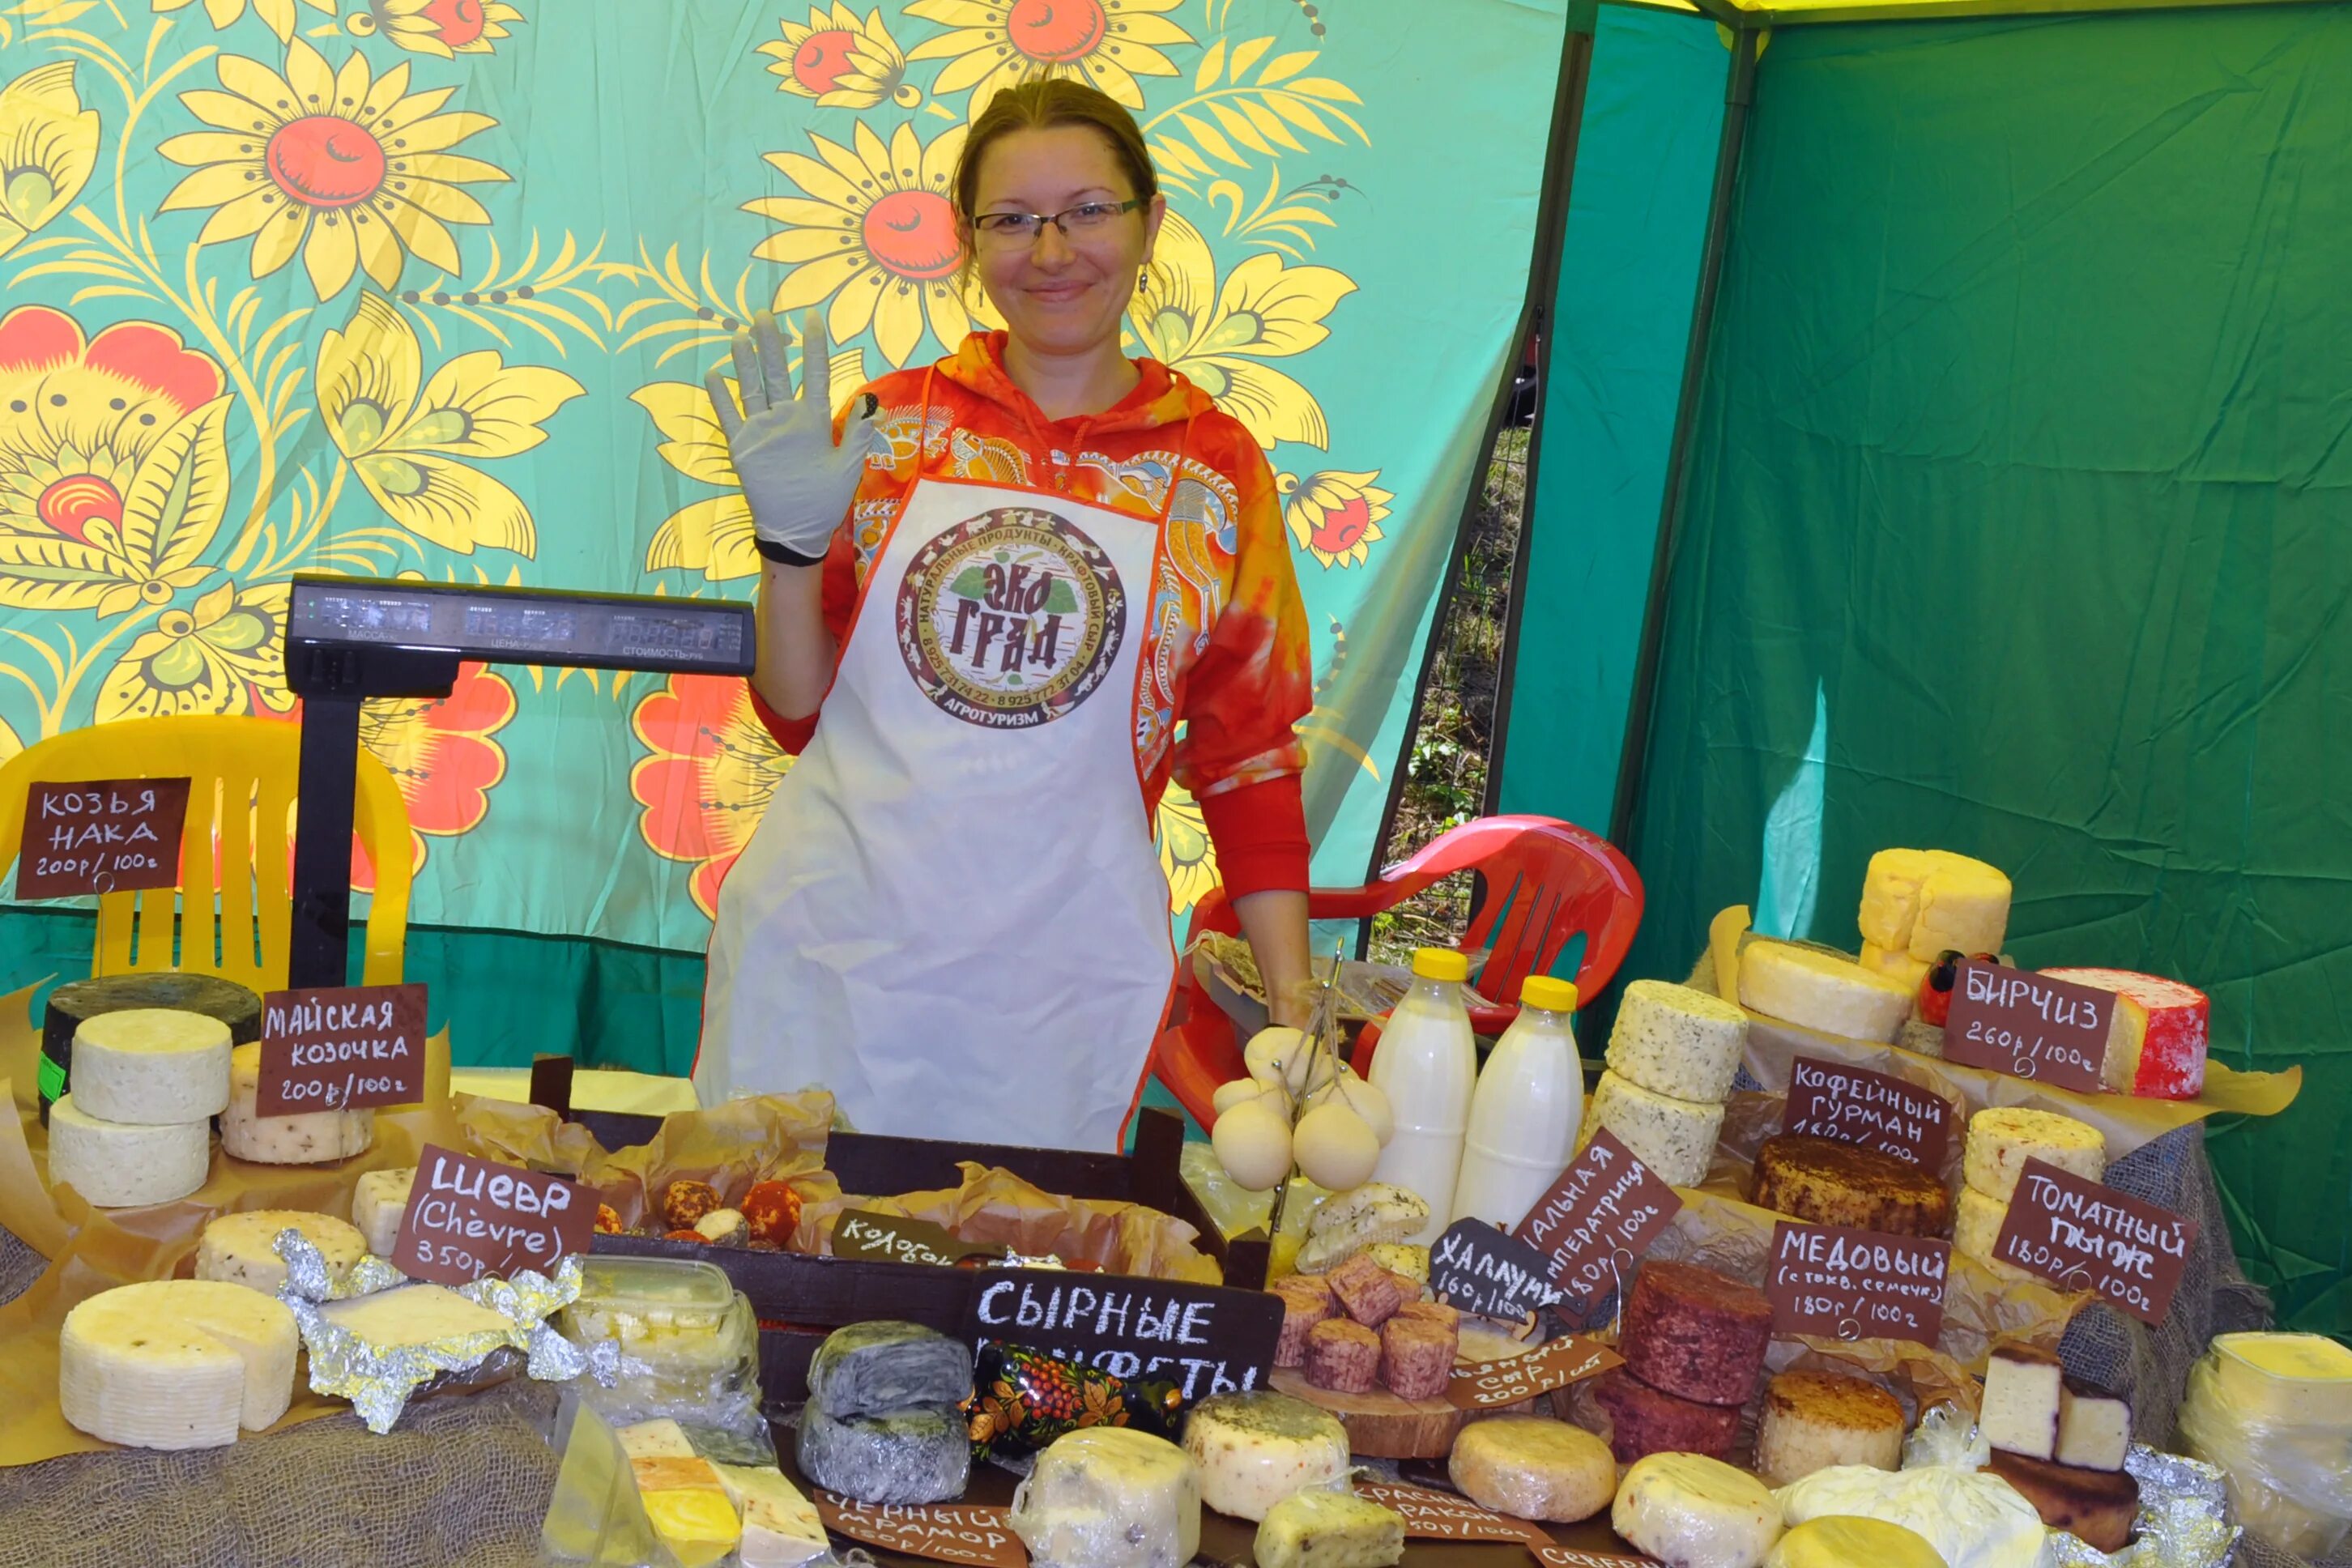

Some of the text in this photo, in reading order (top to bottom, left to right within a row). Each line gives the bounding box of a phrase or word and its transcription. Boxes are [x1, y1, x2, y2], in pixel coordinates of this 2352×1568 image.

[919, 527, 1104, 652] НАТУРАЛЬНЫЕ ПРОДУКТЫ КРАФТОВЫЙ СЫР
[982, 563, 1054, 615] ЭКО
[949, 598, 1062, 673] ГРАД
[927, 647, 941, 669] 925
[940, 668, 957, 687] 731
[958, 682, 973, 697] 74
[974, 690, 989, 703] 22
[998, 696, 1005, 705] 8
[1008, 694, 1032, 706] 925
[1033, 685, 1057, 701] 772
[1058, 675, 1070, 689] 37
[1070, 662, 1084, 676] 04
[944, 698, 1038, 726] АГРОТУРИЗМ
[42, 790, 156, 820] КОЗЬЯ
[49, 821, 159, 851] НАКА
[265, 996, 393, 1039] МАЙСКАЯ
[1966, 966, 2098, 1029] БИРЧИЗ
[291, 1035, 408, 1067] КОЗОЧКА
[1796, 1063, 1941, 1124] КОФЕЙНЫЙ
[1812, 1096, 1922, 1143] ГУРМАН
[1547, 1160, 1645, 1280] МПЕРАТРИЦА
[2028, 1175, 2186, 1259] ТОМАТНЫЙ
[1780, 1229, 1945, 1280] МЕДОВЫЙ
[977, 1280, 1215, 1345] СЫРНЫЕ
[1353, 1487, 1481, 1510] КРАСНЫ
[1376, 1502, 1502, 1523] РАКОН
[838, 1512, 1007, 1549] МРАМОР
